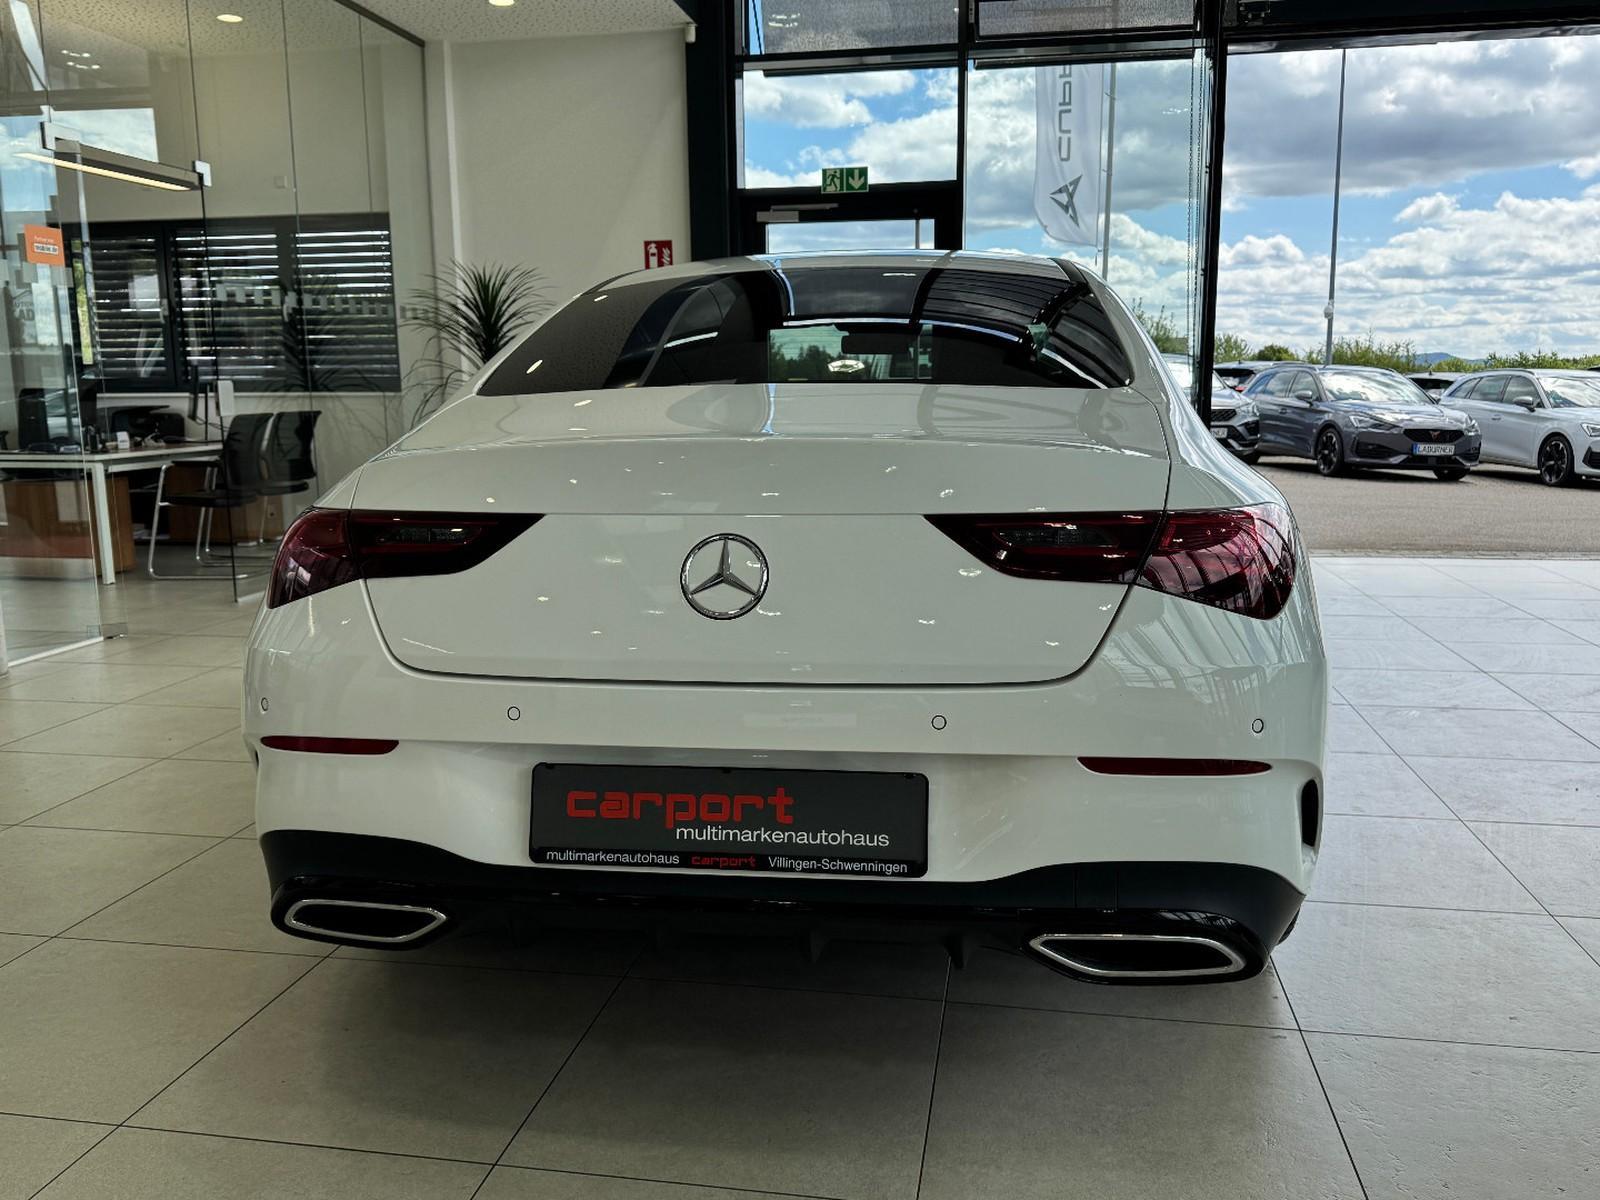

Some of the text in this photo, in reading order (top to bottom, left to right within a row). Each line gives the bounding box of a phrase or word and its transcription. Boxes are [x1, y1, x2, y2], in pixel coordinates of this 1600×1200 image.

[566, 787, 794, 829] carport
[675, 825, 890, 847] multimarkenautohaus
[546, 849, 908, 875] multimarkenautohaus carport Villingen-Schwenningen
